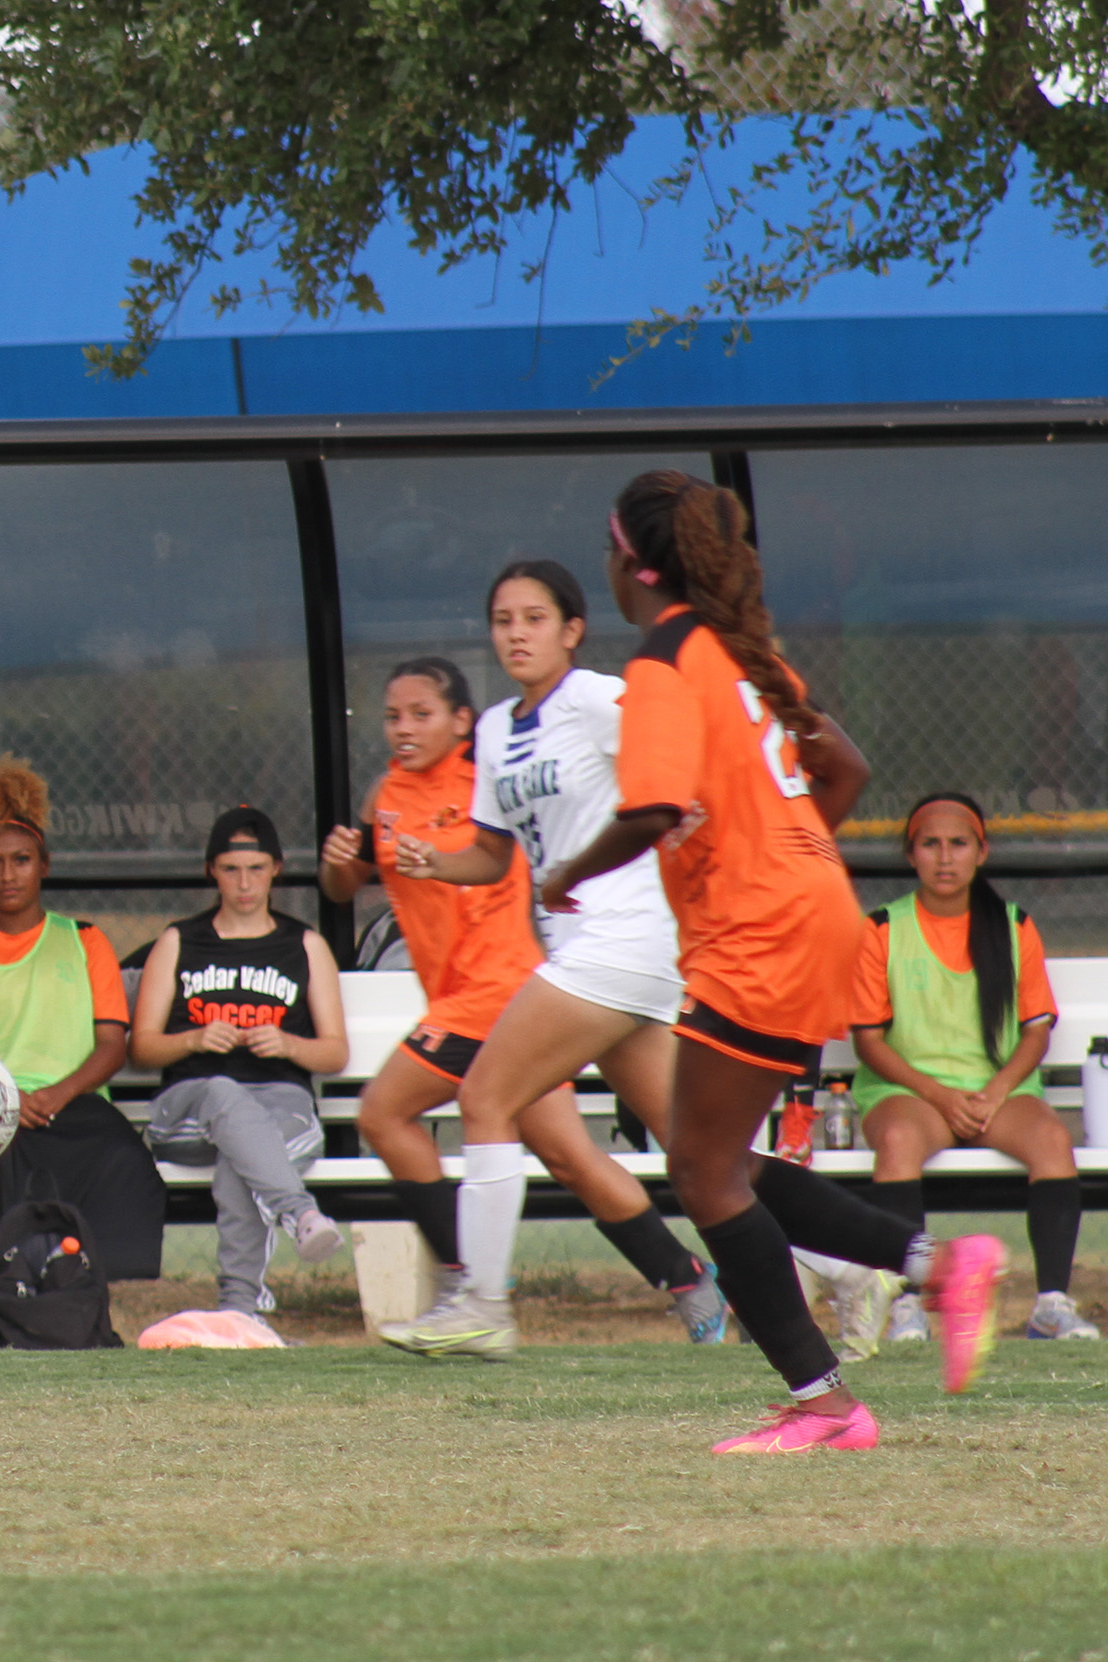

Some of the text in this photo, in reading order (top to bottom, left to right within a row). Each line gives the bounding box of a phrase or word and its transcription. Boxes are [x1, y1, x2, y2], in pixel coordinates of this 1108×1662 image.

[180, 964, 298, 1007] Cedar Valley
[187, 997, 287, 1028] Soccer
